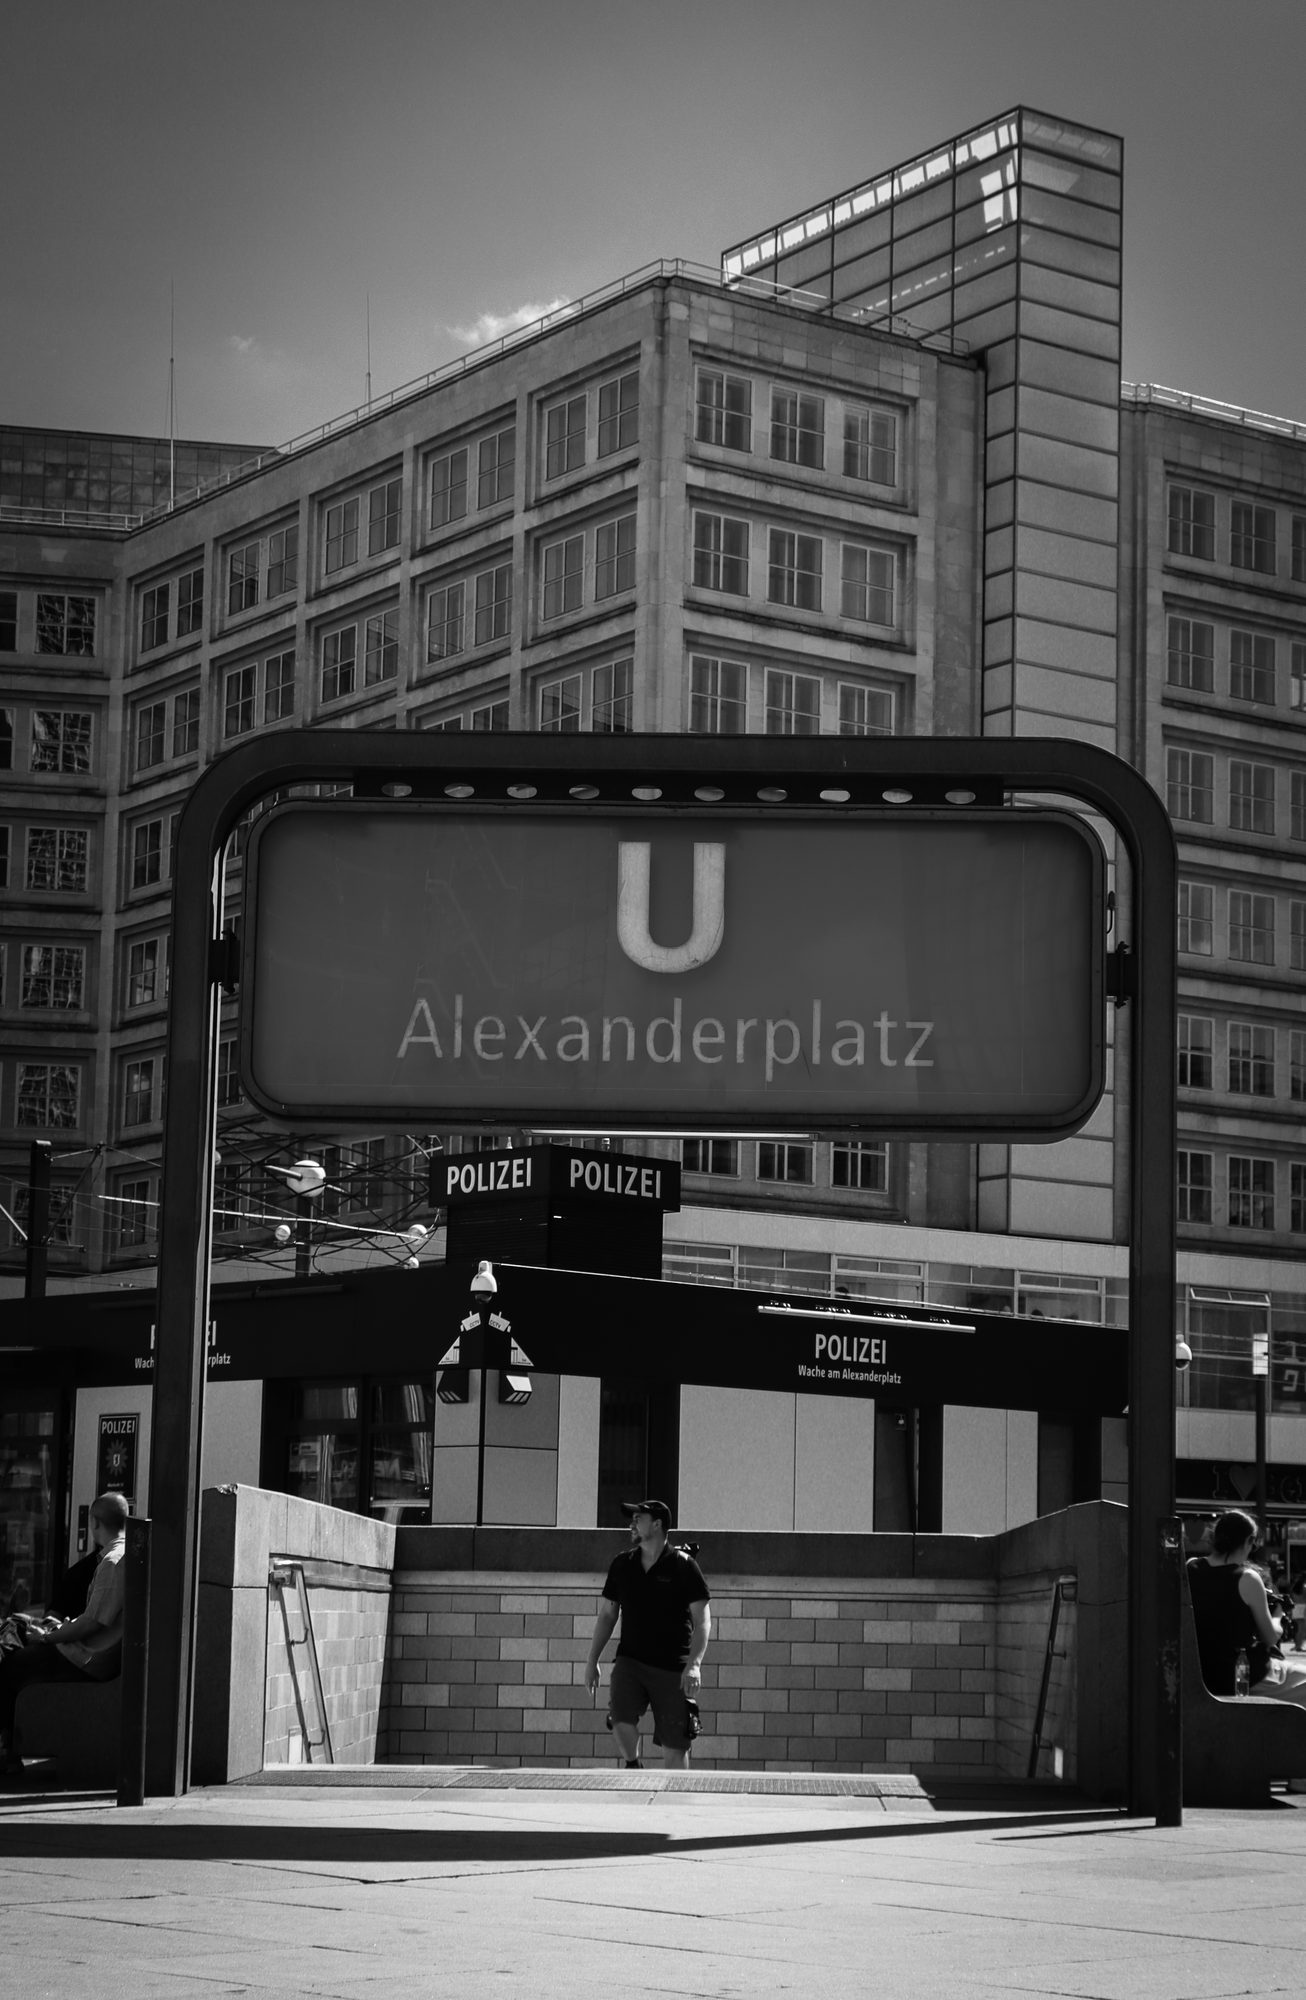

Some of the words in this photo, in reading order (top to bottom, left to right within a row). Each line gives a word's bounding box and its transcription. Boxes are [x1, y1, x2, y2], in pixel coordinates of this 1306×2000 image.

[617, 842, 725, 972] U
[397, 996, 935, 1082] Alexanderplatz
[446, 1157, 532, 1195] POLIZEI
[570, 1158, 661, 1198] POLIZEI
[469, 1319, 480, 1328] CCTV
[489, 1319, 502, 1329] CCTV
[815, 1333, 886, 1364] POLIZEI
[134, 1356, 156, 1370] Wach
[798, 1364, 825, 1378] Wache
[827, 1369, 840, 1379] am
[842, 1368, 902, 1385] Alexanderplatz
[101, 1420, 136, 1435] POLIZEI
